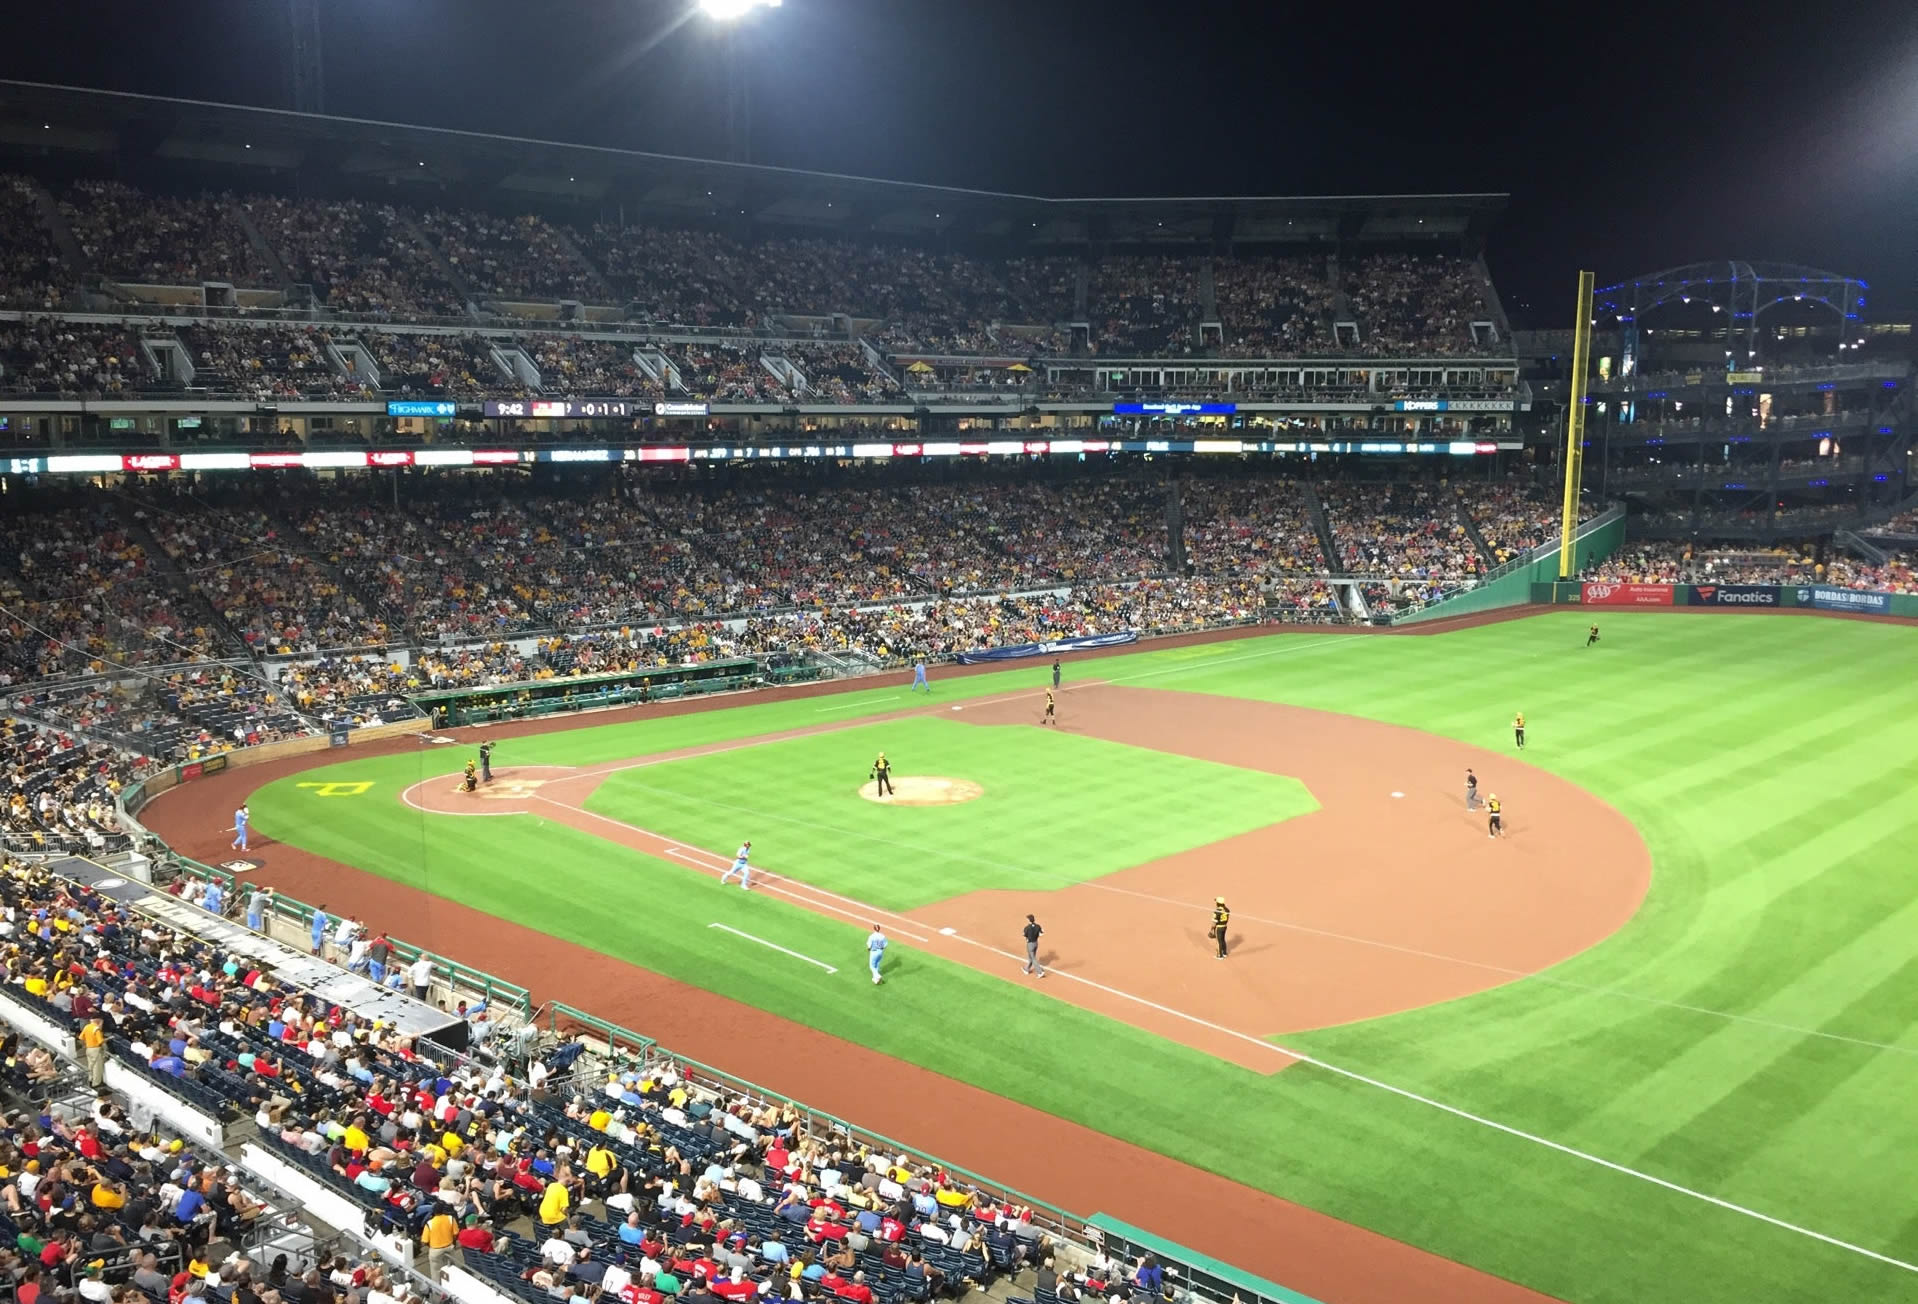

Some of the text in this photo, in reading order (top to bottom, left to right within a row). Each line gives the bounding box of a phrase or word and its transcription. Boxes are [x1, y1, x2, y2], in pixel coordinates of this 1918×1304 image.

[498, 403, 524, 415] 9:42
[1404, 401, 1438, 410] KOPPERS
[1589, 585, 1609, 597] AAA
[1717, 590, 1773, 603] Fanatics
